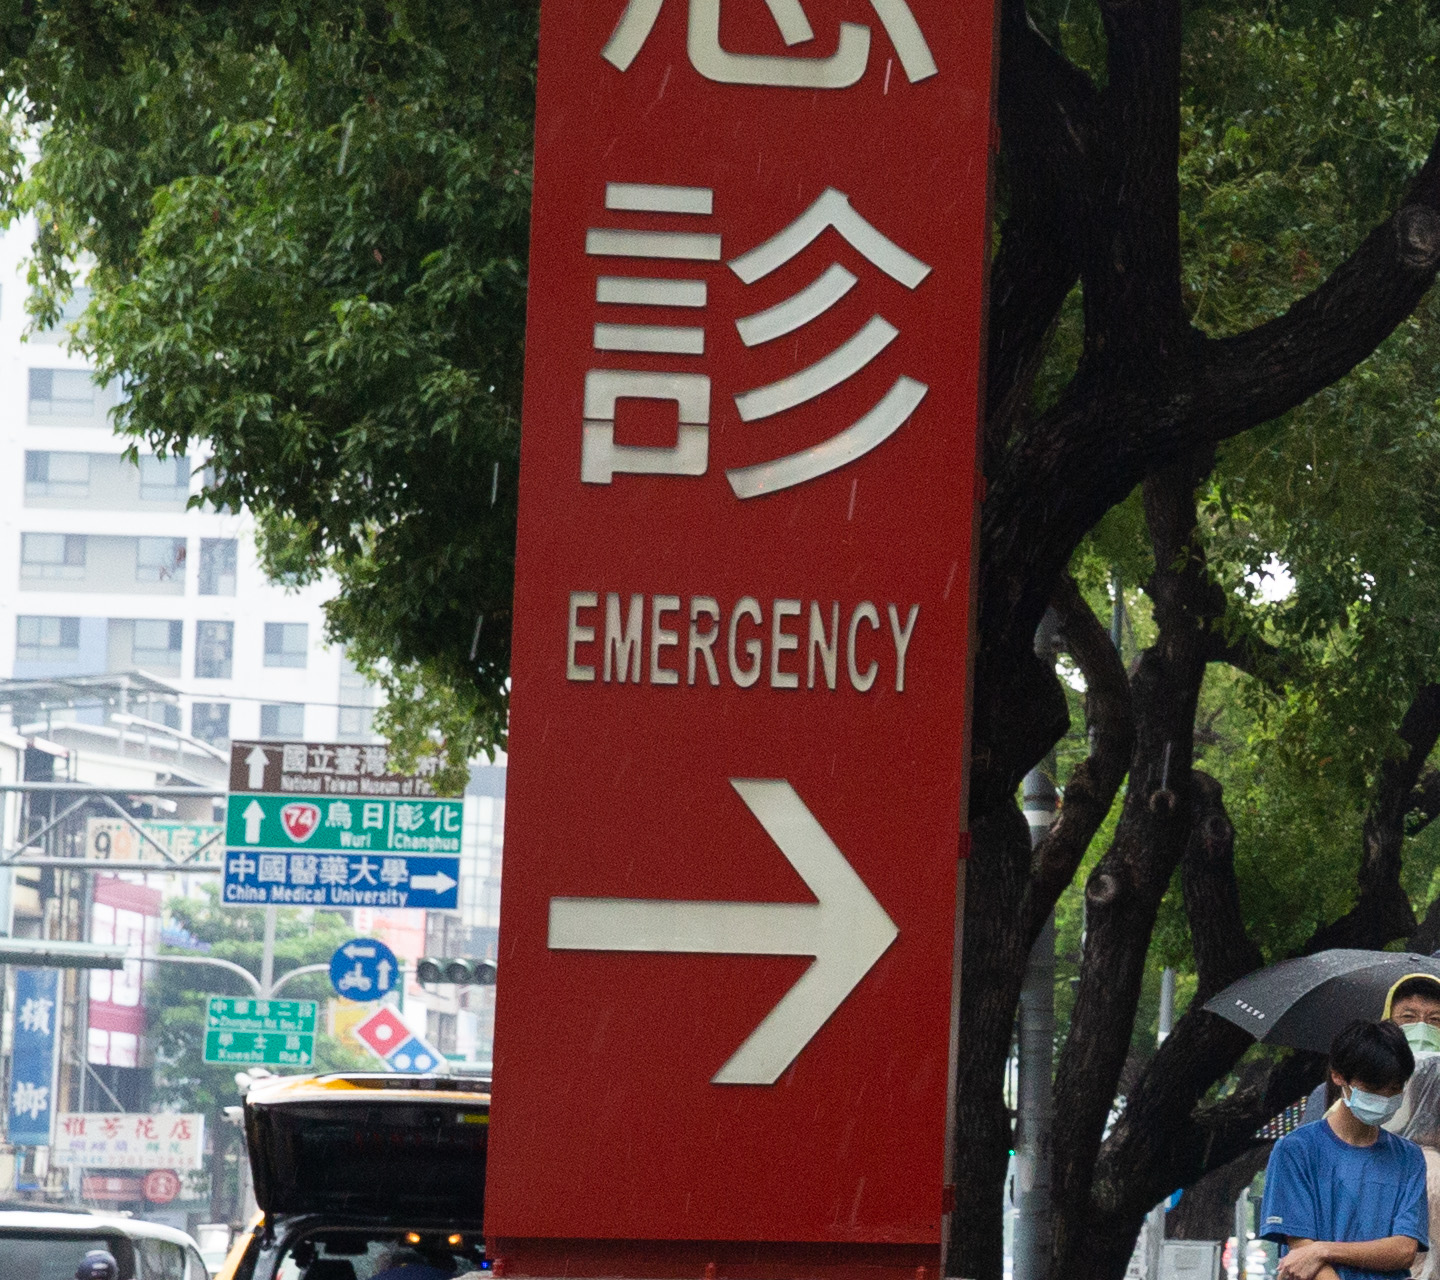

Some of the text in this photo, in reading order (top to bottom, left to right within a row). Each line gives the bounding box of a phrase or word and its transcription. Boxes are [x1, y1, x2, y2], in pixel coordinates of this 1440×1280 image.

[565, 590, 921, 694] EMERGENCY
[360, 777, 400, 794] Museum
[402, 779, 413, 795] of
[287, 808, 313, 828] 74
[396, 803, 461, 833] 彰化
[339, 831, 459, 853] Wuri Changhua
[228, 852, 410, 887] 中國醫藥大學
[226, 883, 409, 908] China Medical University
[1235, 999, 1266, 1020] VOLVO
